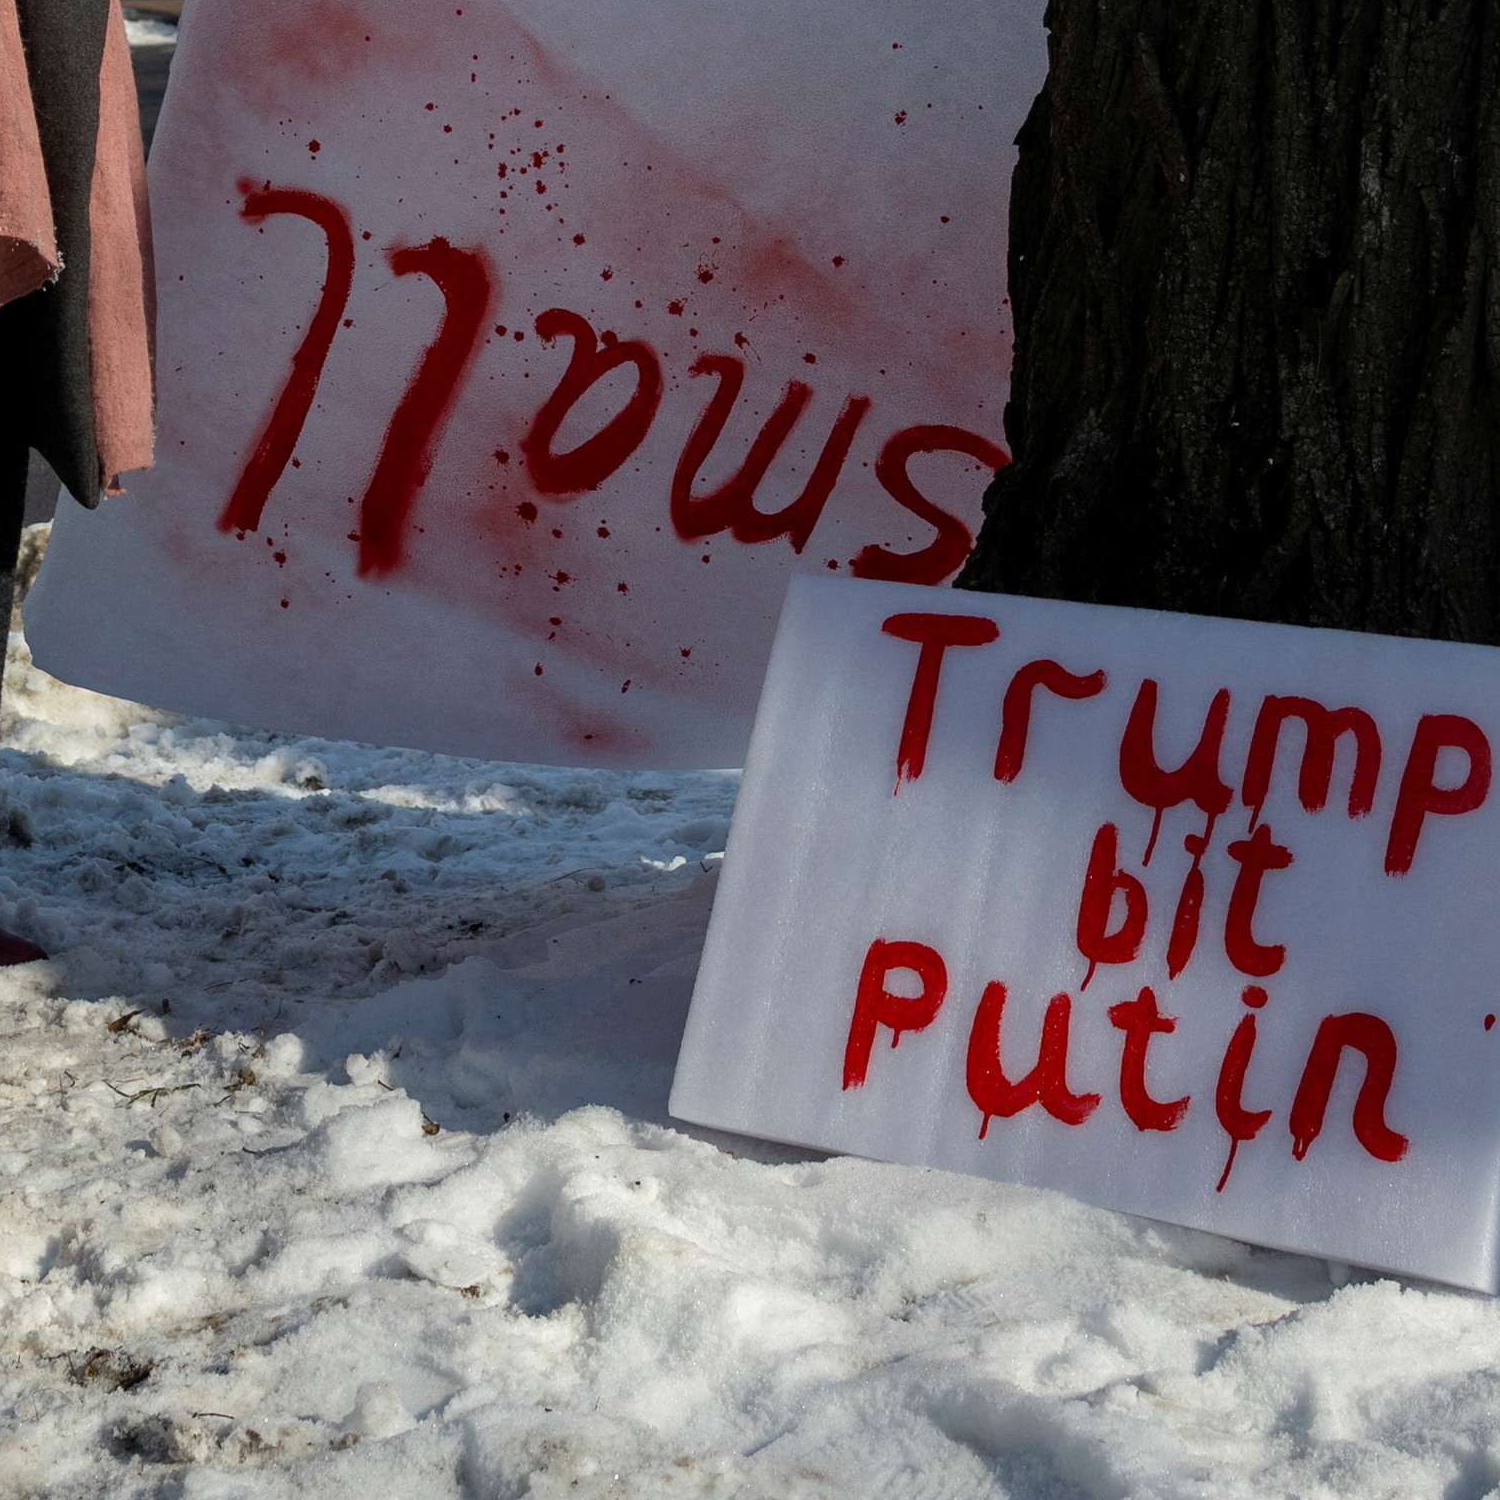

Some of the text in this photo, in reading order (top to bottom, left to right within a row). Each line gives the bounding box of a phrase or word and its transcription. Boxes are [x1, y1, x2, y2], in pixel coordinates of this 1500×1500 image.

[881, 612, 1492, 877] Trump
[1076, 822, 1293, 991] bit
[841, 937, 1409, 1192] Putin
